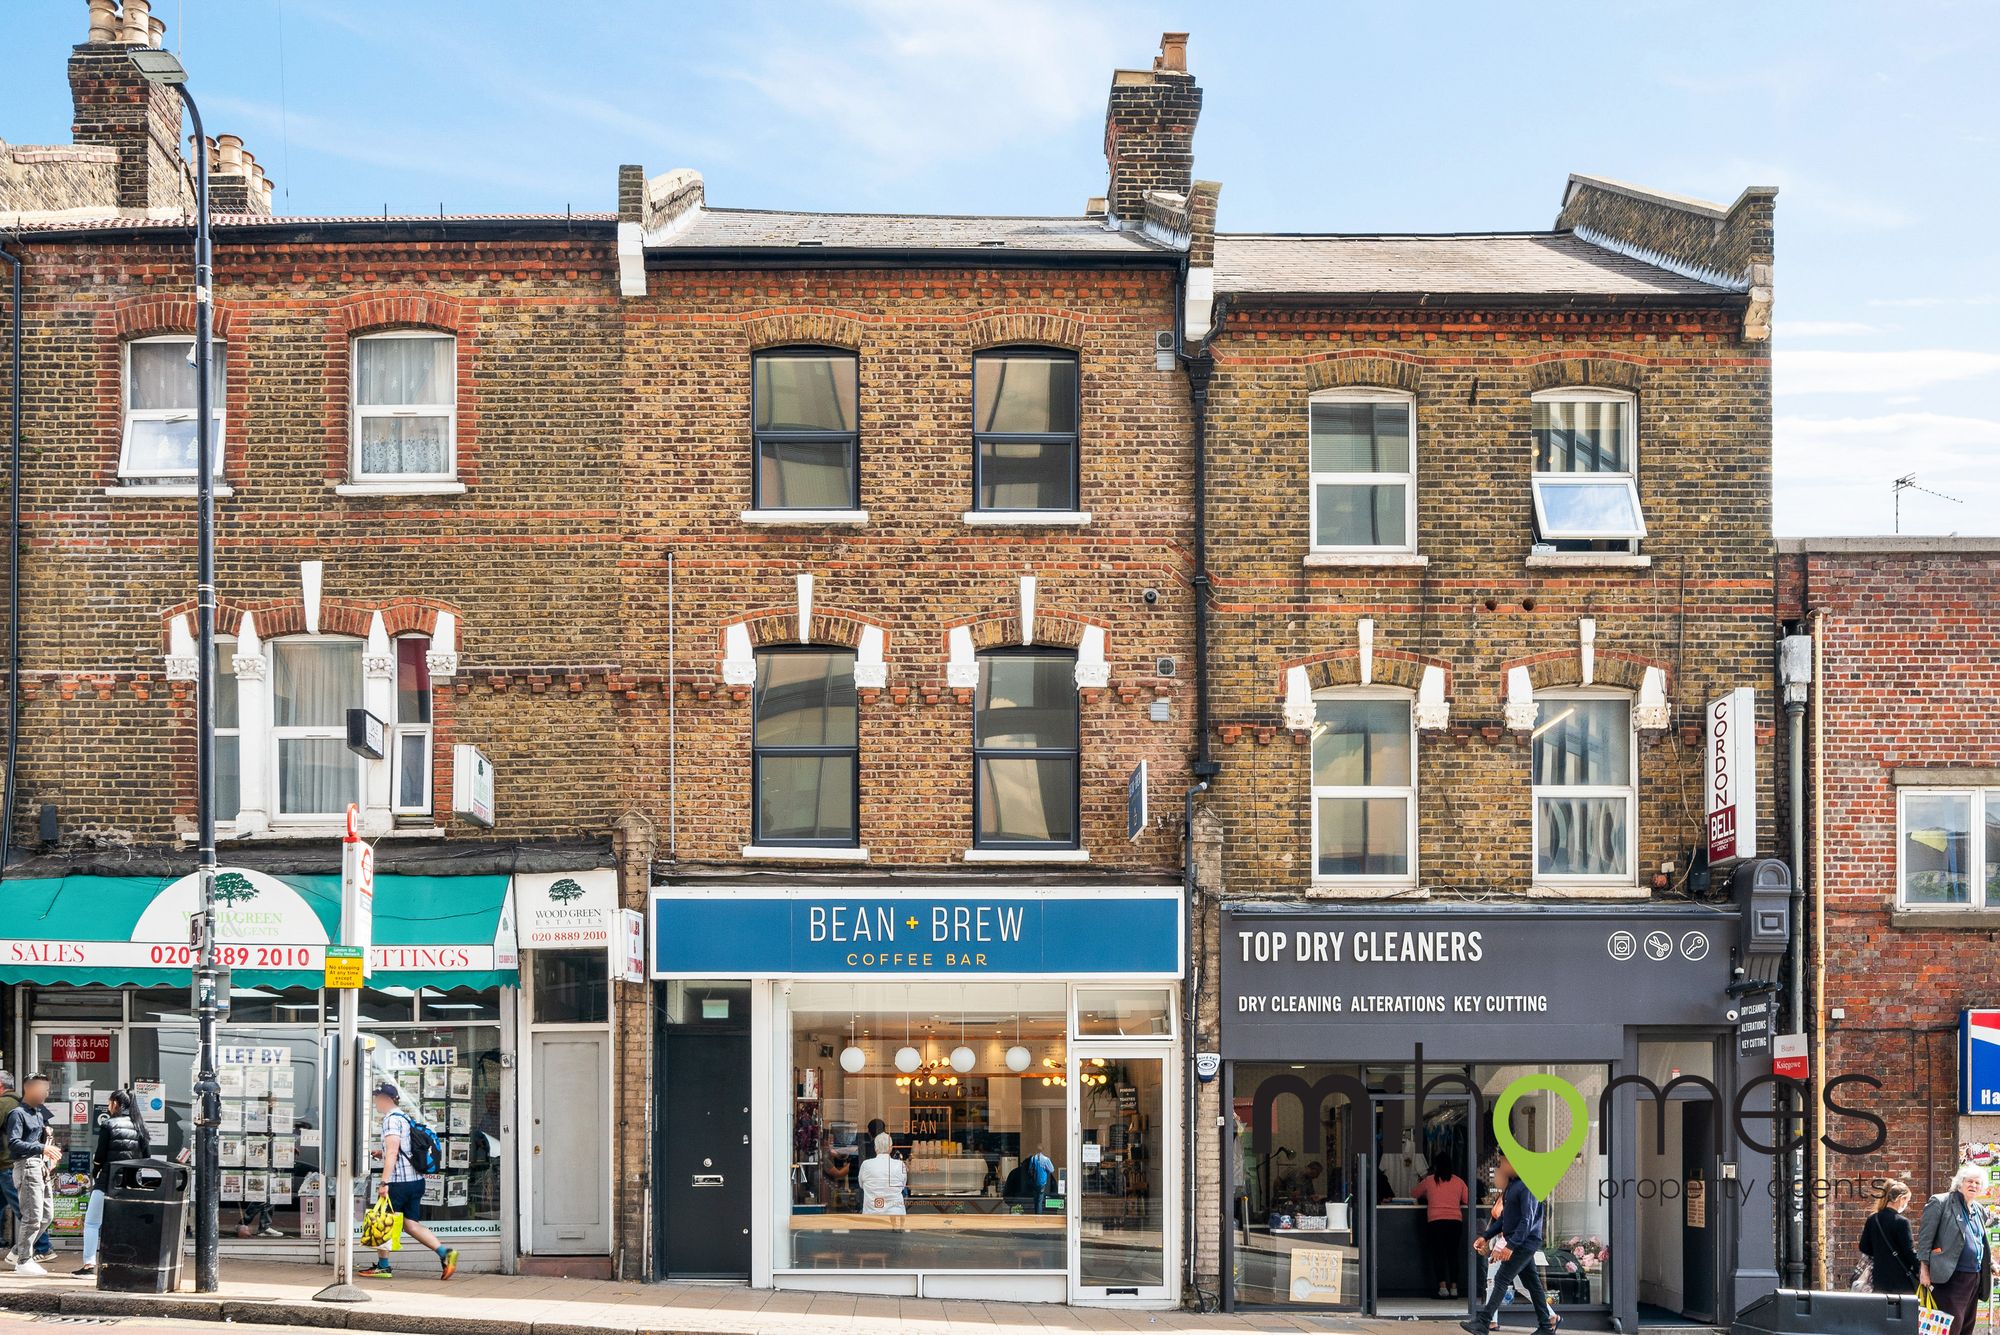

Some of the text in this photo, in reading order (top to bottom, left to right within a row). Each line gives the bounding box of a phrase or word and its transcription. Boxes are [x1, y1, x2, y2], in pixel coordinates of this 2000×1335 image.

[1714, 702, 1728, 809] CORDON
[1711, 811, 1735, 841] BELL
[535, 908, 601, 918] WOOD GREEN
[810, 906, 895, 942] BEAN
[932, 906, 1024, 942] BREW
[531, 931, 607, 941] 020 8889 2010
[11, 943, 84, 963] SALES
[1238, 931, 1484, 962] TOP DRY CLEANERS
[151, 945, 190, 964] 020
[257, 947, 310, 967] 2010
[371, 949, 469, 967] ETTINGS
[847, 953, 988, 966] COFFEE BAR
[1238, 995, 1547, 1012] DRY CLEANING ALTERATIONS KEY CUTTING
[1748, 1003, 1767, 1014] CLEANING
[1741, 1020, 1767, 1032] ALTERATIONS
[53, 1038, 109, 1048] HOUSES & FLATS
[1741, 1037, 1767, 1049] KEY CUTTING
[66, 1050, 96, 1060] WANTED
[225, 1048, 283, 1064] LET BY
[390, 1049, 454, 1066] FOR SALE
[70, 1091, 90, 1100] open
[903, 1120, 937, 1135] BEAN
[1310, 1268, 1336, 1282] CUT
